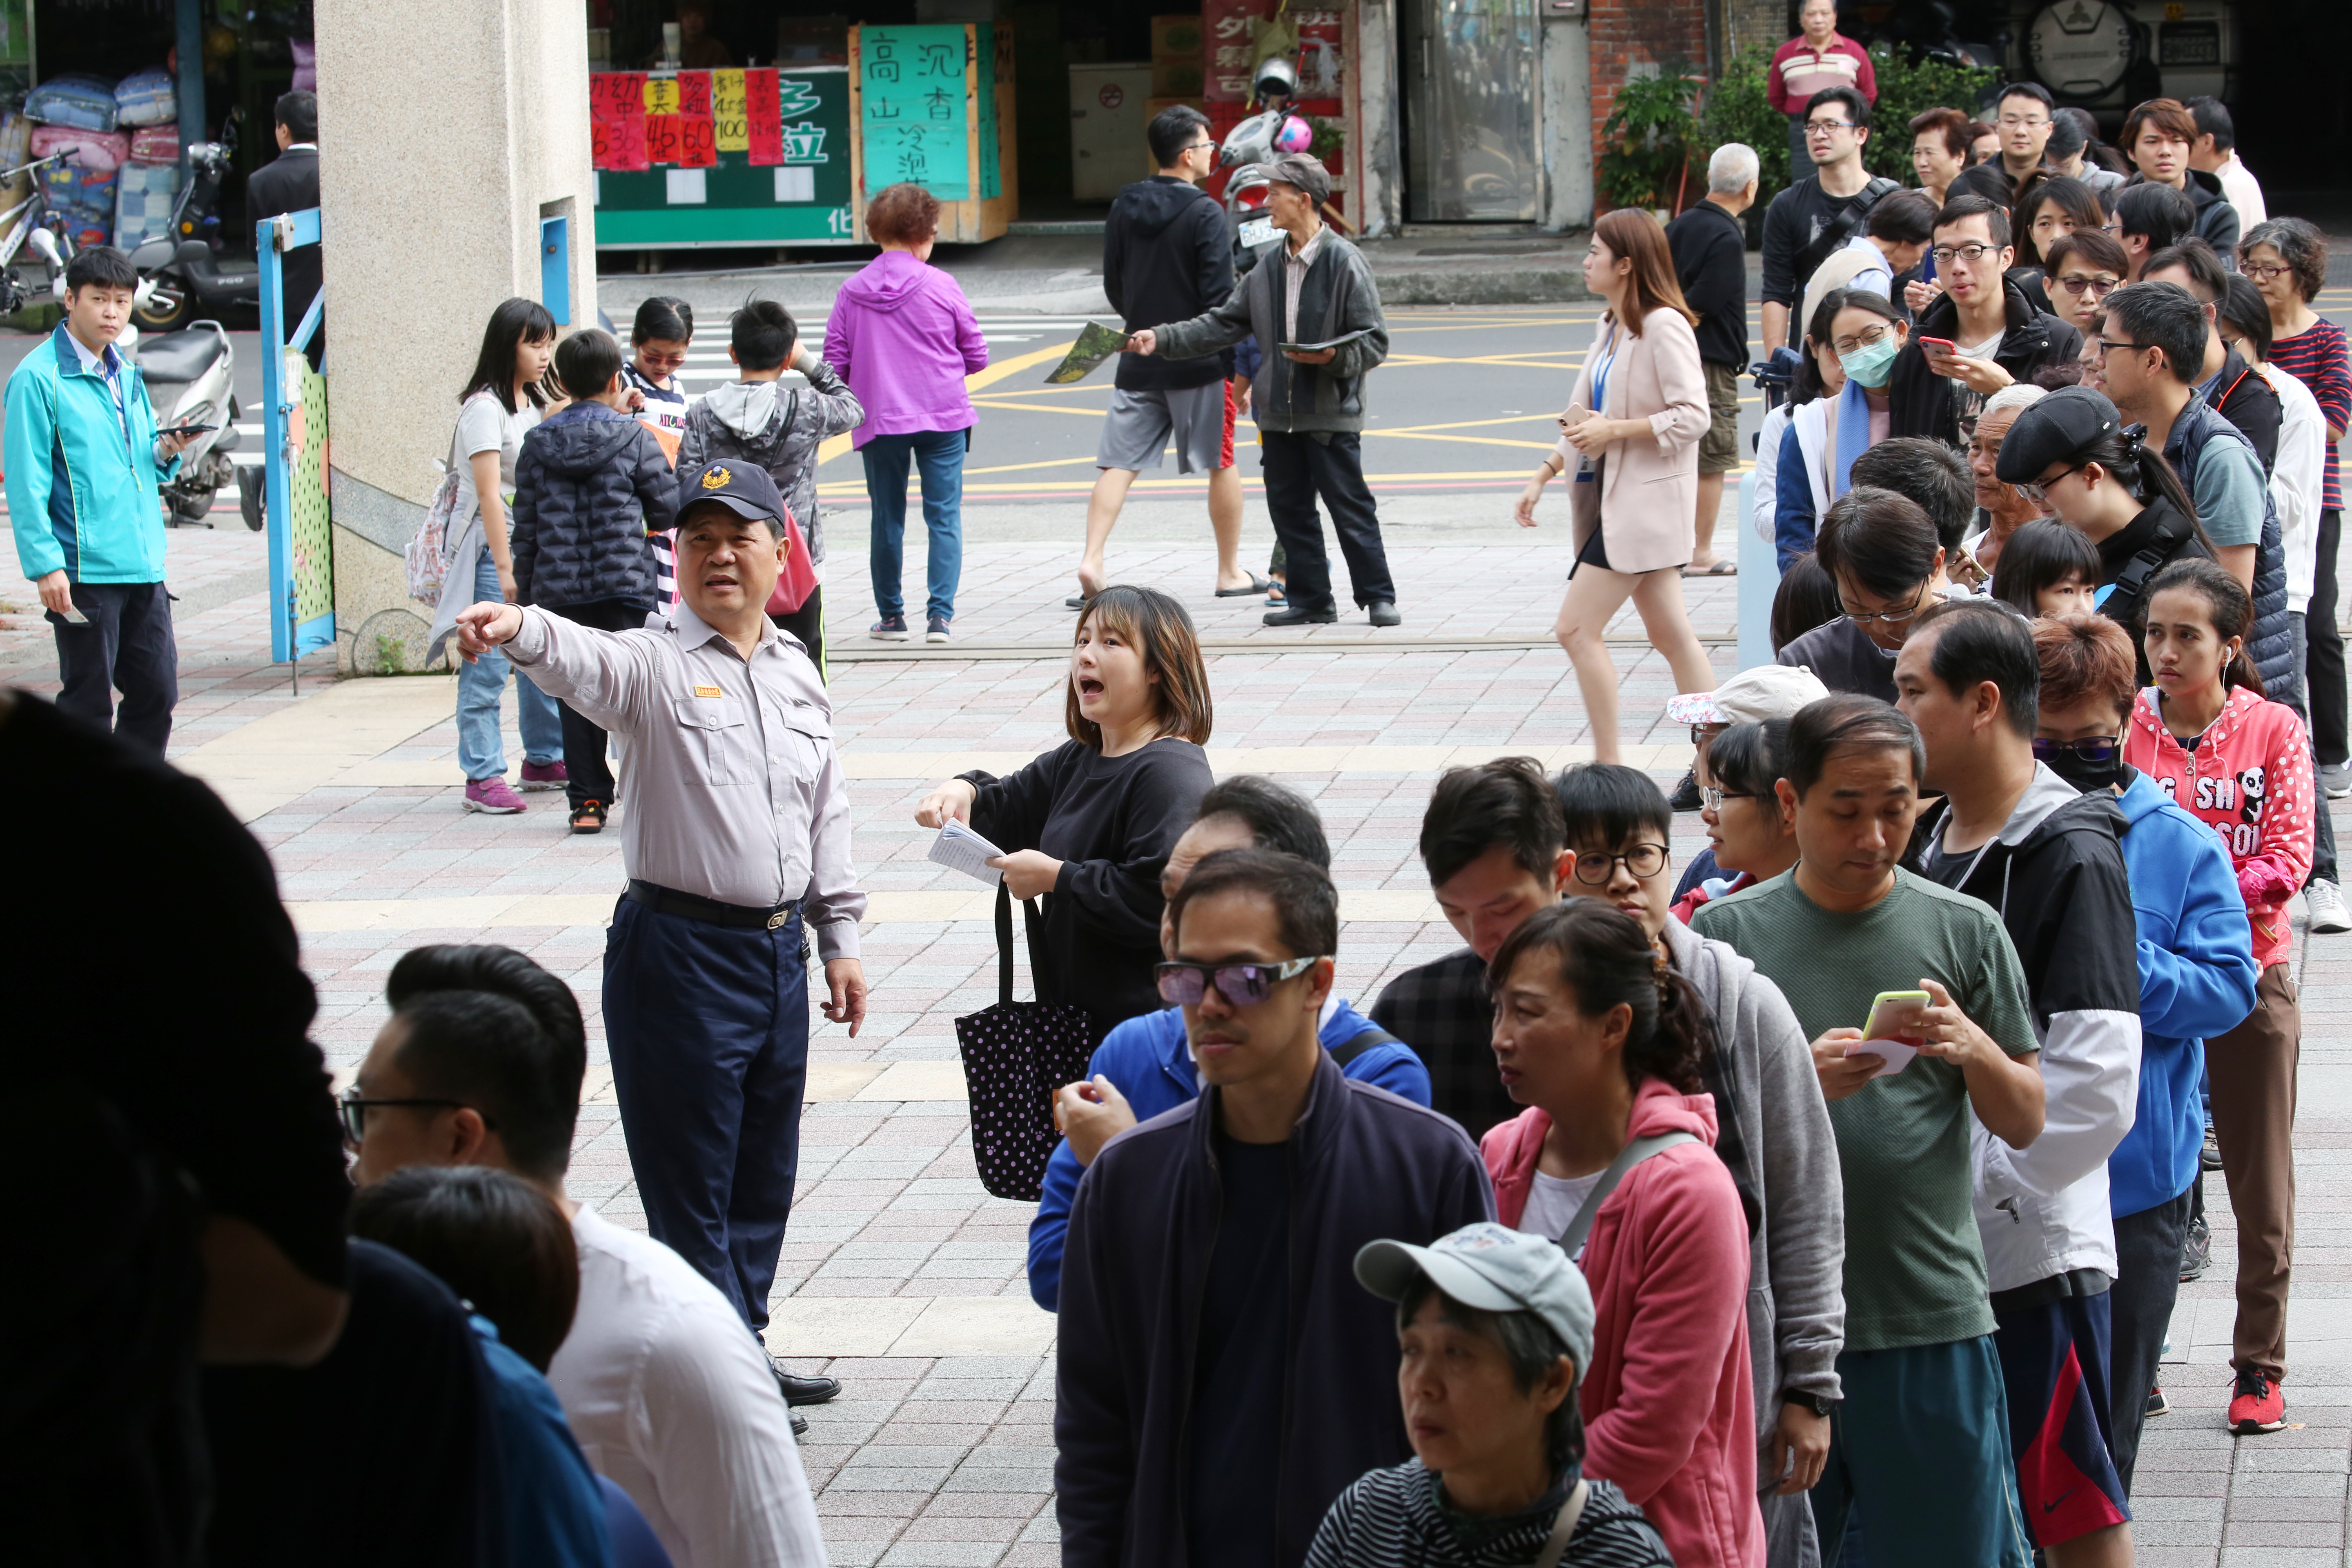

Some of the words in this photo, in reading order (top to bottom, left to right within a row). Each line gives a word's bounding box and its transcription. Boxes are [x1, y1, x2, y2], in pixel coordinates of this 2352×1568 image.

[869, 32, 900, 118] 高山
[917, 44, 961, 120] 沉香
[612, 127, 637, 151] 36
[647, 117, 676, 148] 46
[684, 121, 712, 149] 60
[720, 119, 746, 138] 100
[2196, 776, 2235, 810] SH
